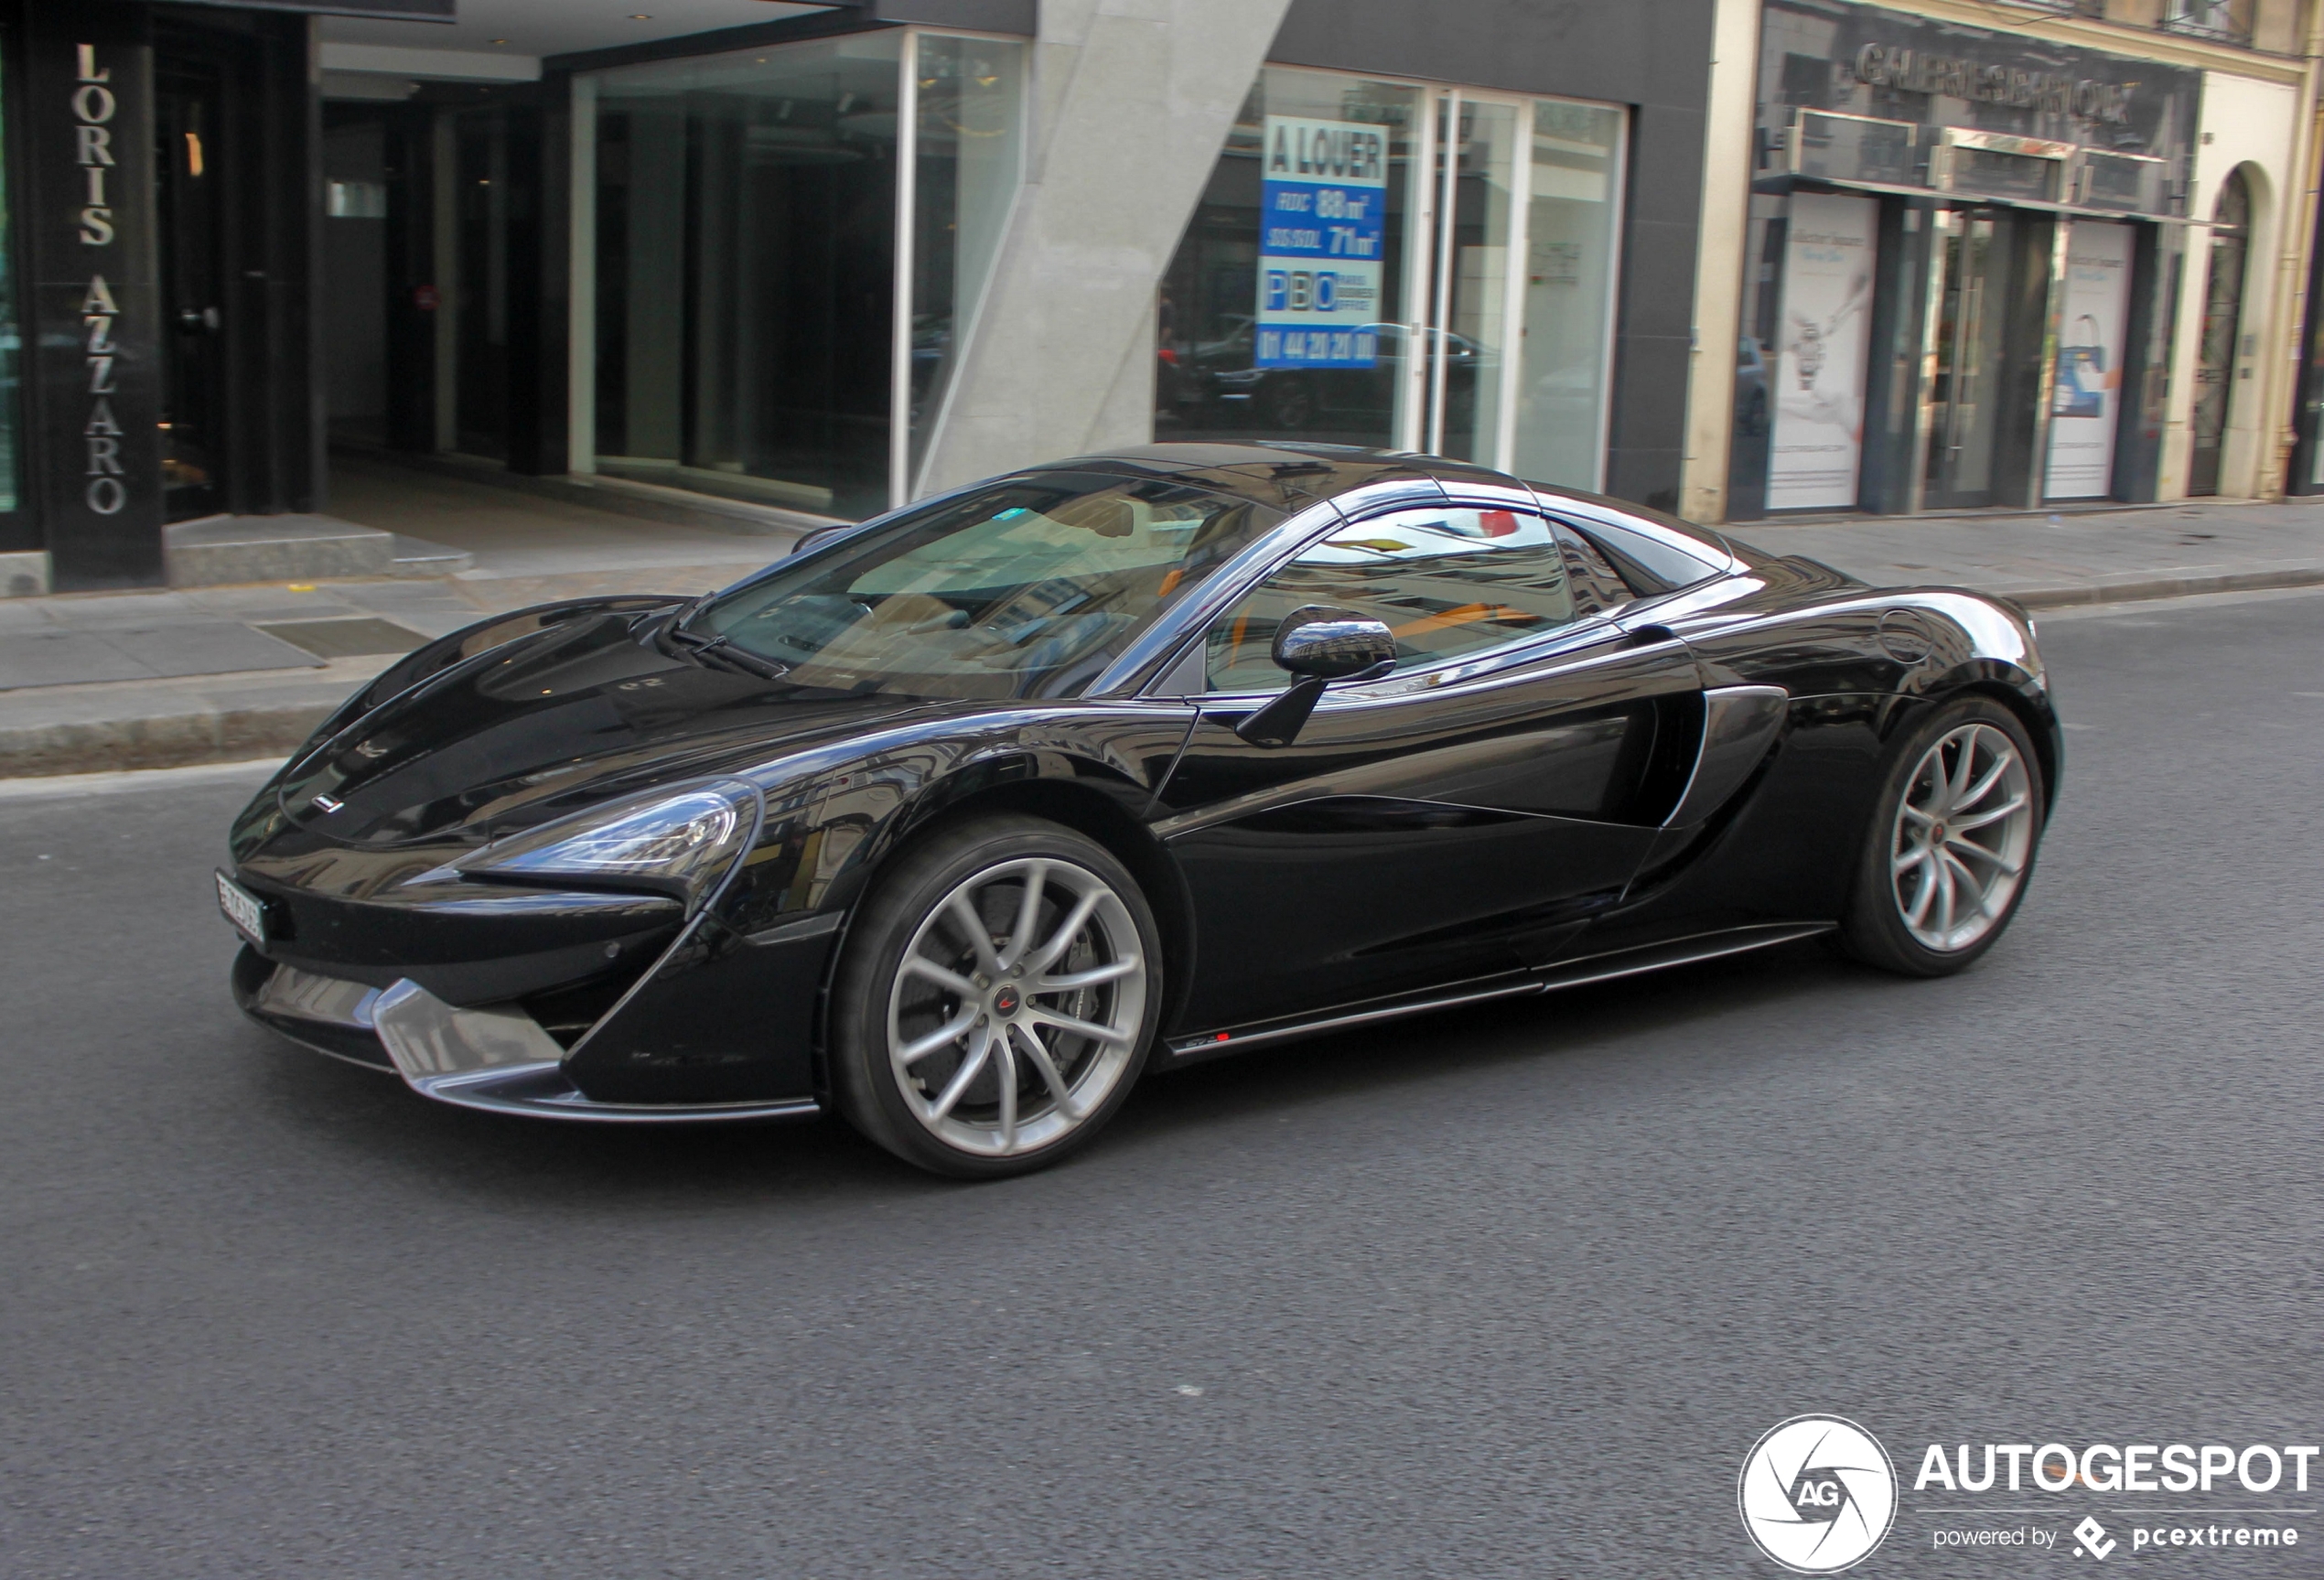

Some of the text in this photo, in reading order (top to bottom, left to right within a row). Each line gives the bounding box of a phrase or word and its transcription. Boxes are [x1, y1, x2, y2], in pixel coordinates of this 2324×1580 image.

[1269, 124, 1381, 178] A LOUER
[72, 44, 126, 515] LORIS AZZARO
[1264, 270, 1336, 311] PBO
